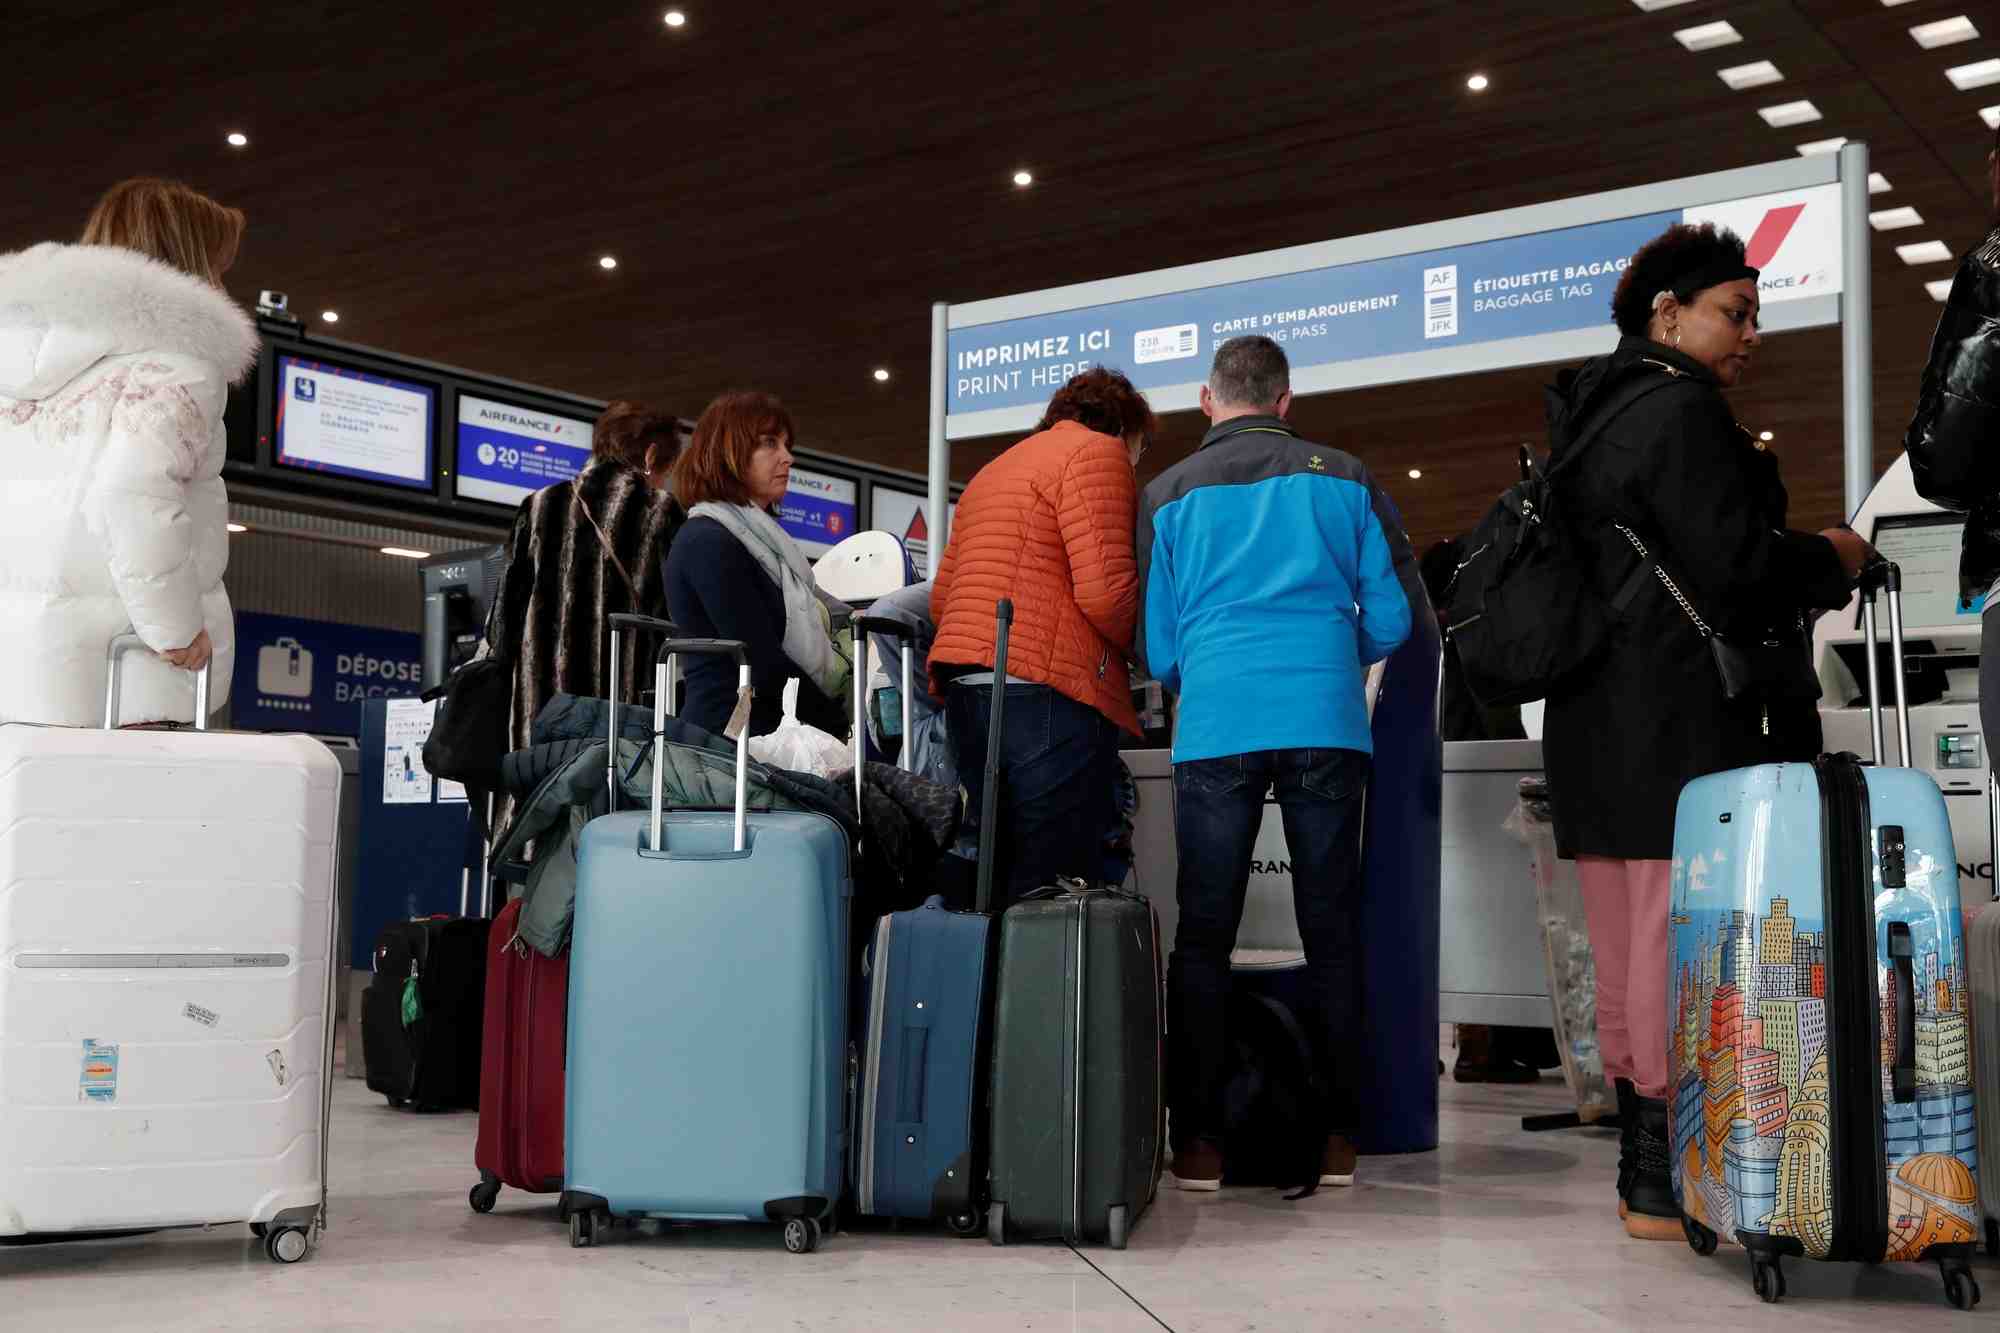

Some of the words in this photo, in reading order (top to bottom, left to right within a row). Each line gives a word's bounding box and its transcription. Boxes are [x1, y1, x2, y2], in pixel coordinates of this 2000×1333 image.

[1431, 272, 1451, 286] AF
[1473, 269, 1559, 294] ÉTIQUETTE
[1473, 288, 1553, 313] BAGGAGE
[1559, 283, 1593, 300] TAG
[1212, 316, 1258, 334] CARTE
[1262, 294, 1400, 325] D'EMBARQUEMENT
[1431, 320, 1451, 333] JFK
[1292, 323, 1328, 341] PASS
[957, 335, 1070, 371] IMPRIMEZ
[1079, 329, 1111, 353] ICI
[957, 370, 1023, 398] PRINT
[498, 446, 520, 465] 20
[336, 652, 421, 682] DÉPOSE
